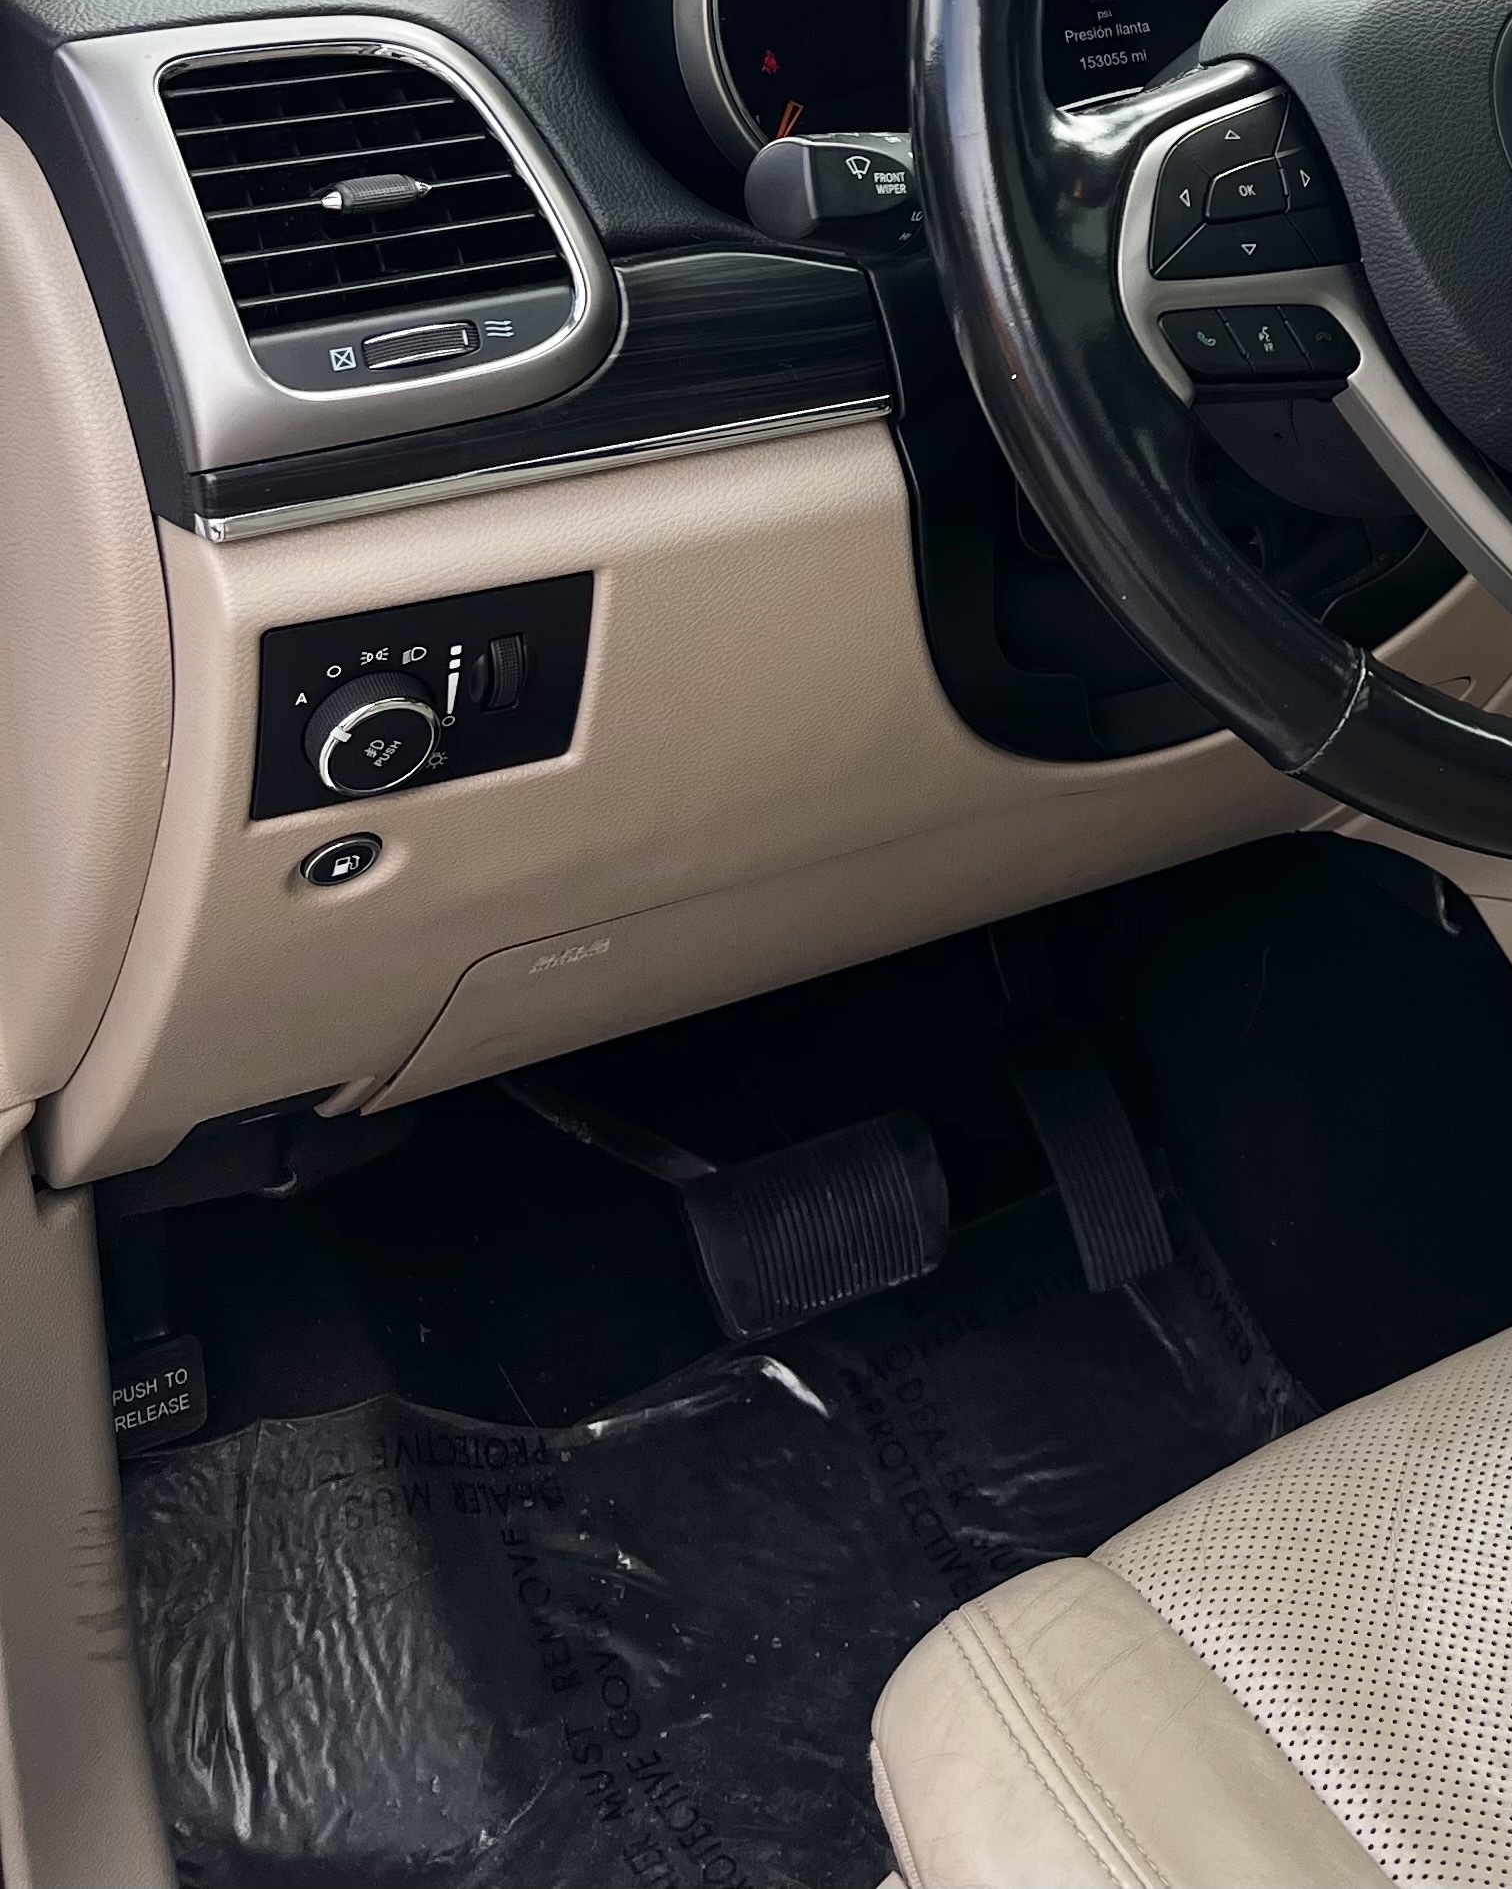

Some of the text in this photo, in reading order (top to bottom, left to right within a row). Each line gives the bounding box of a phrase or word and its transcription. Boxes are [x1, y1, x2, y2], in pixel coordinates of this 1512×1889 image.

[1096, 8, 1113, 22] psi
[1064, 21, 1151, 44] Presión llanta
[1080, 48, 1149, 71] 153055 mi
[873, 171, 906, 183] FRONT
[875, 183, 907, 195] WIPER
[1238, 184, 1257, 198] OK
[295, 692, 308, 706] A
[371, 739, 403, 768] PUSH
[112, 1368, 188, 1407] PUSH TO
[114, 1393, 191, 1433] RELEASE
[500, 1527, 582, 1695] REMOVE
[562, 1718, 635, 1823] MUST
